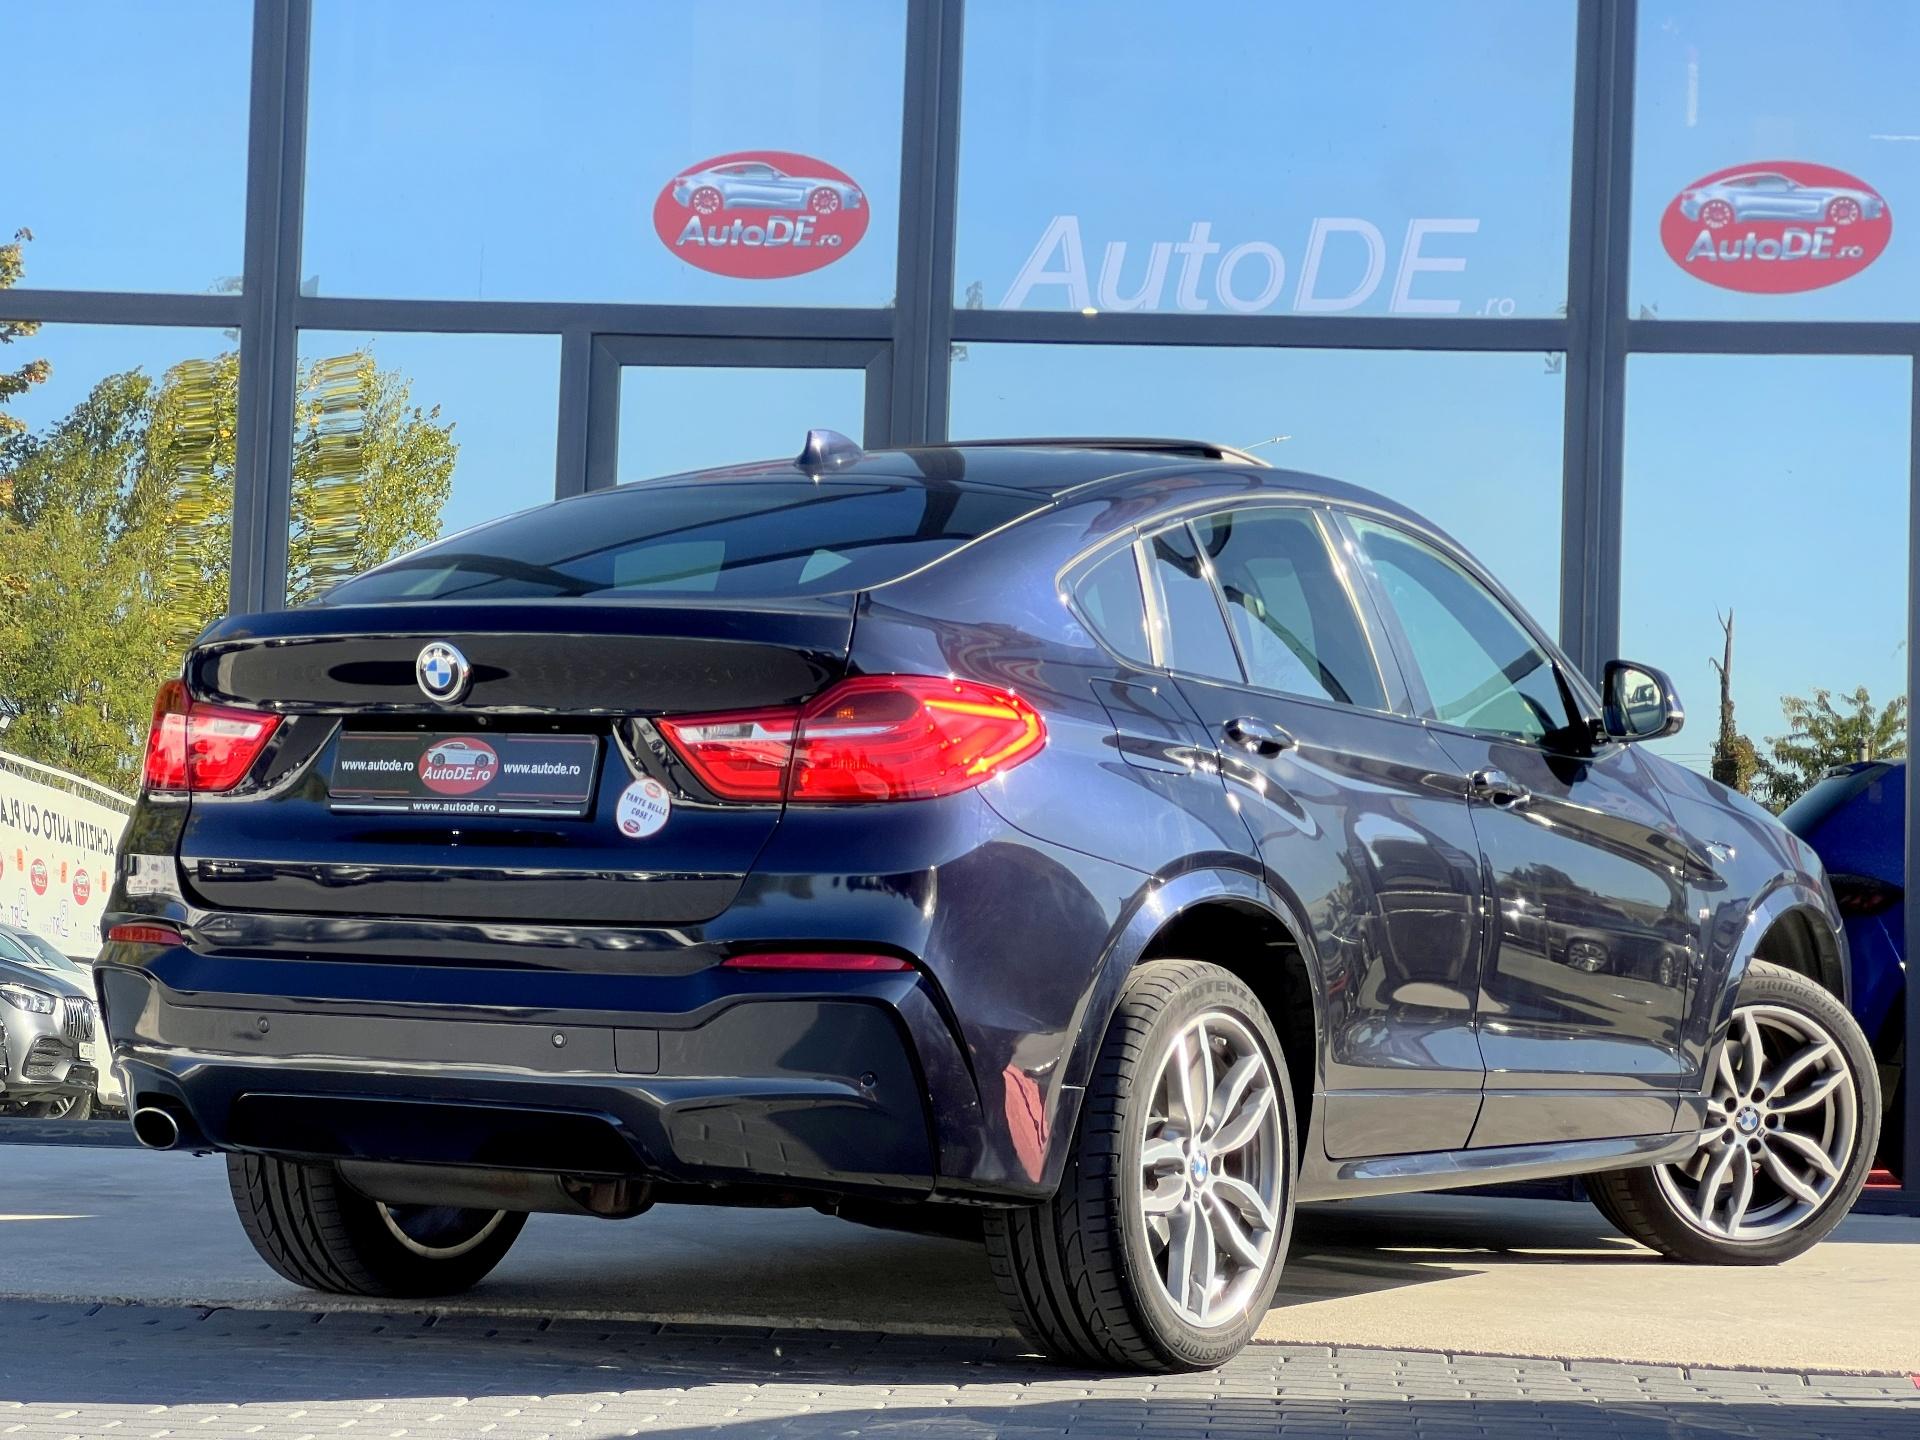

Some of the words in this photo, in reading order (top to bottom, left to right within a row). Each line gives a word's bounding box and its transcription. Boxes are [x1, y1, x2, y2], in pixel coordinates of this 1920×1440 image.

[341, 760, 414, 772] www.autode.ro
[503, 762, 581, 775] www.autode.ro
[422, 766, 491, 781] AutoDE.ro
[412, 802, 496, 812] www.autode.ro
